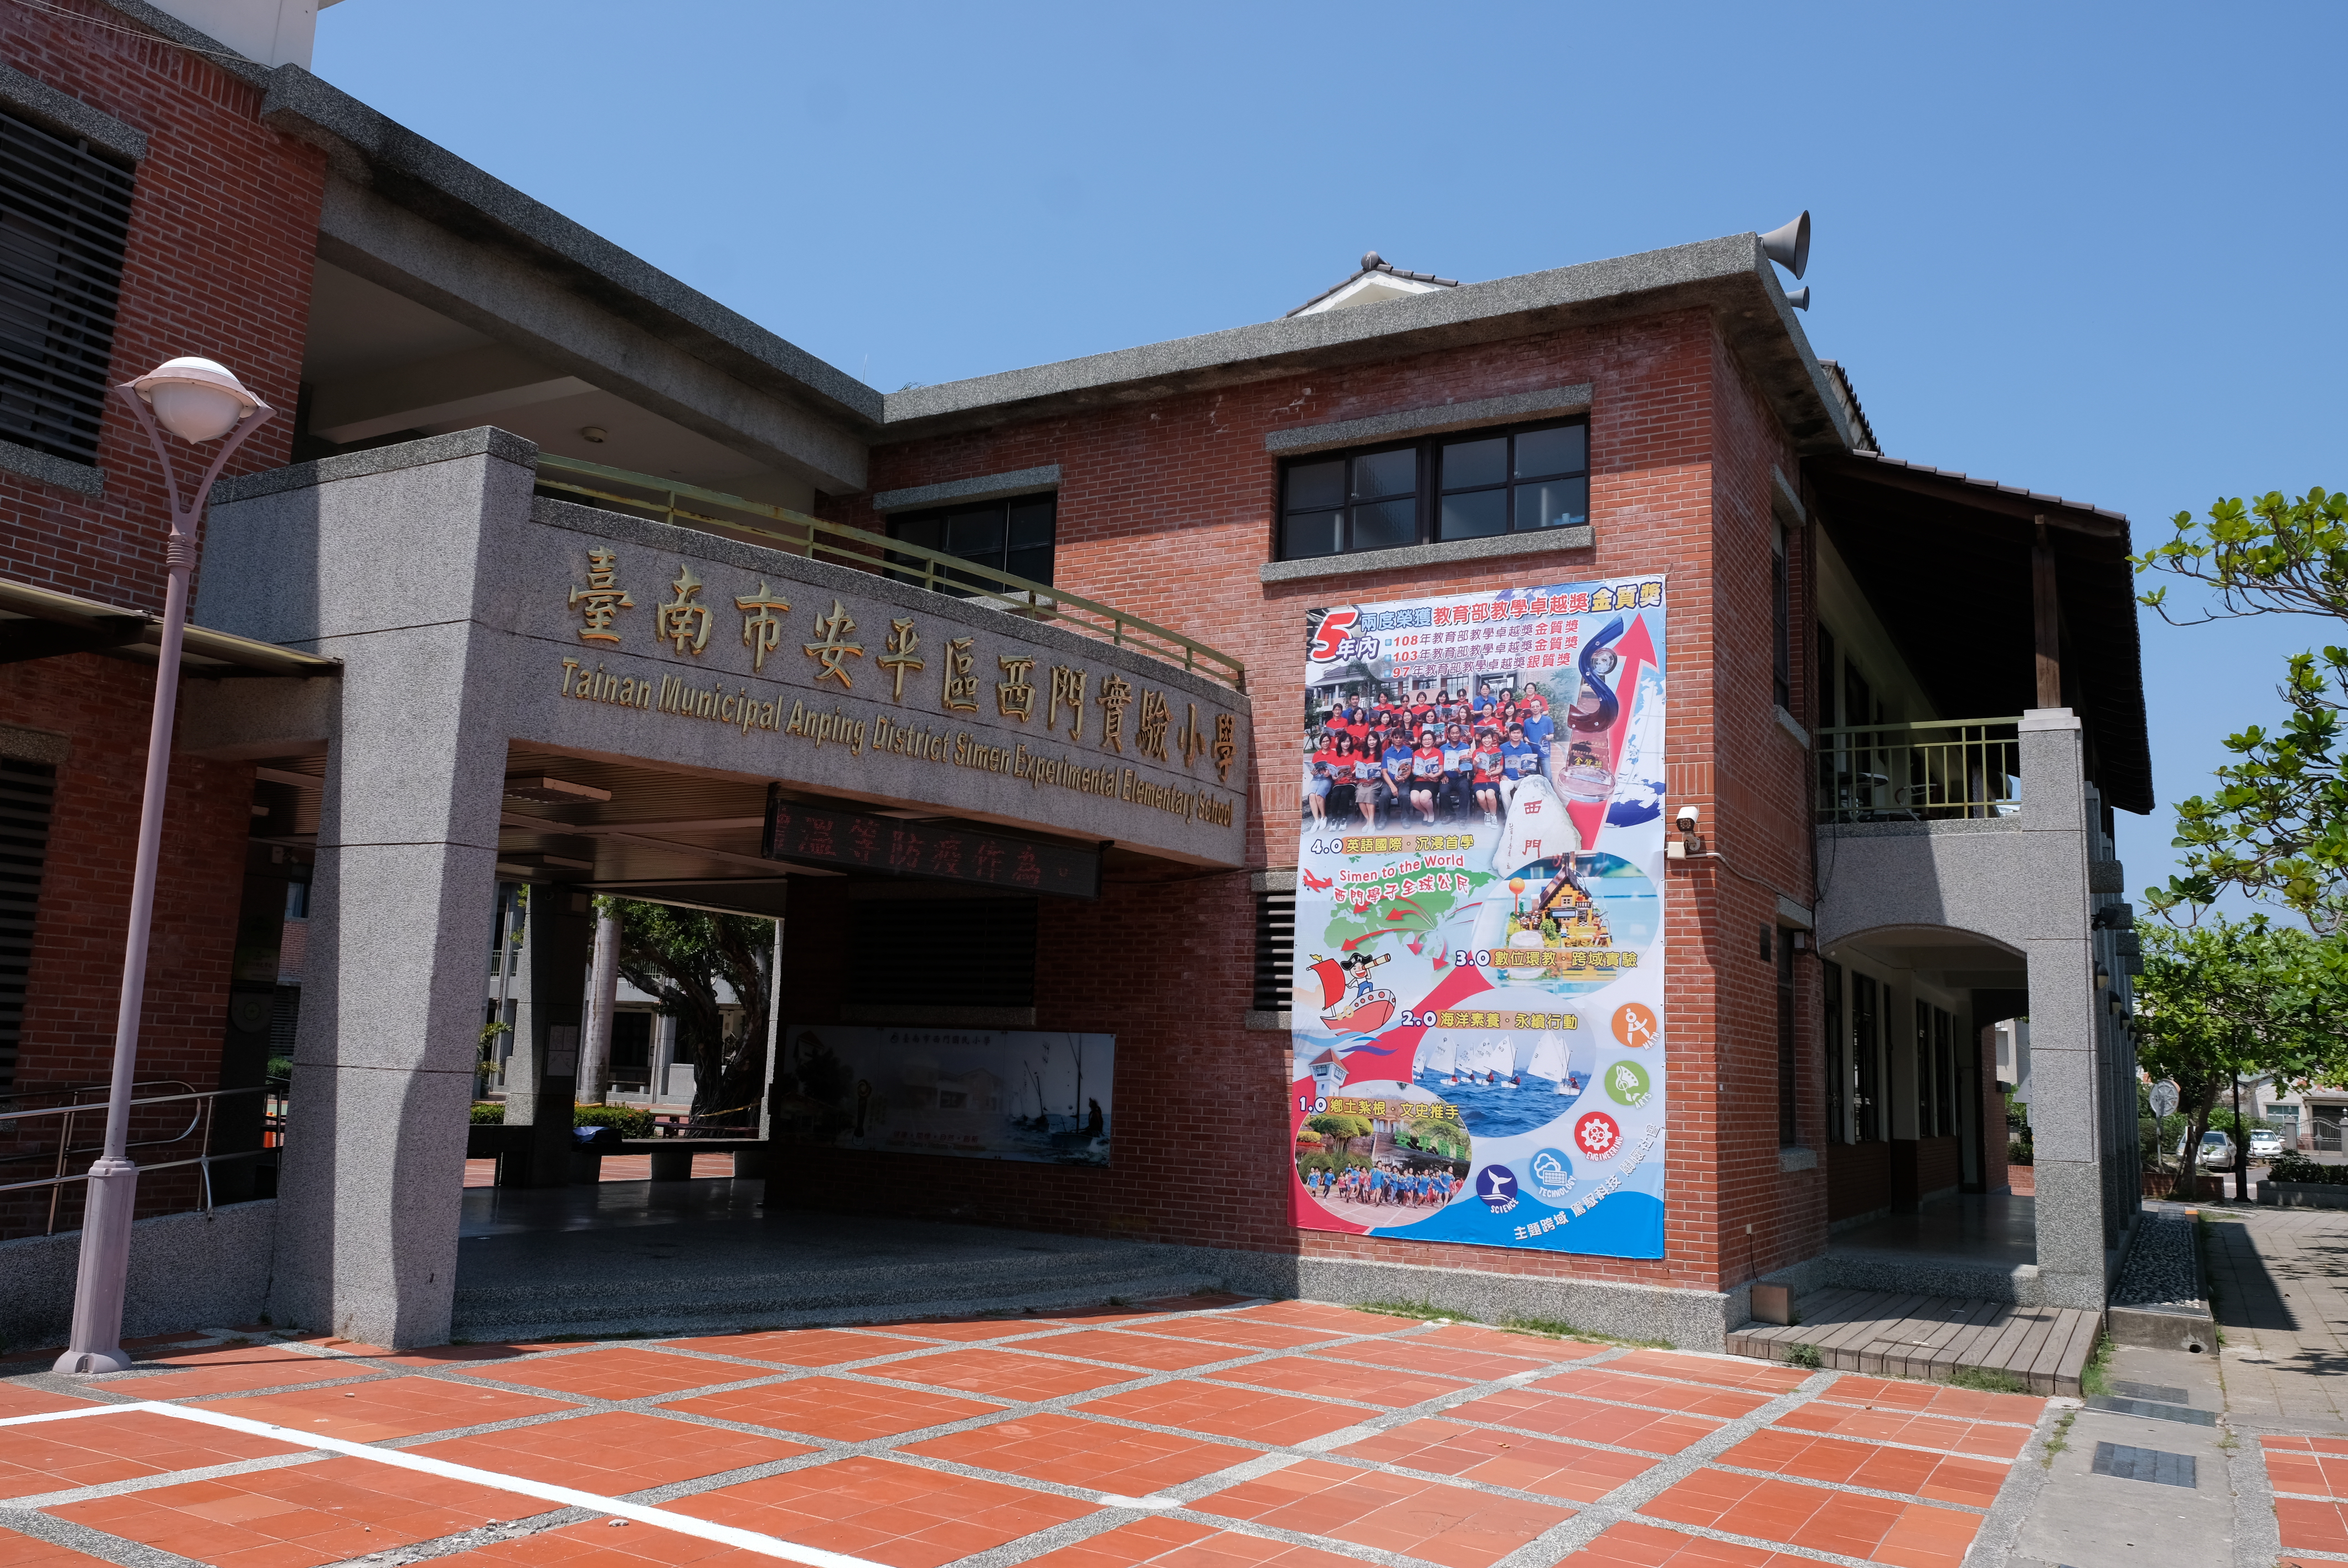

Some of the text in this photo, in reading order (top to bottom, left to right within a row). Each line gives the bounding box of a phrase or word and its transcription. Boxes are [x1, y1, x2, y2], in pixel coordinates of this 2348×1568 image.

[568, 545, 1237, 782] 臺南市安平區西門實驗小學
[562, 656, 1234, 827] Tainan Municipal Anping District Simen Experimental Elementary School
[1311, 838, 1343, 854] 4.0
[1339, 854, 1464, 882] Simen to the World
[1333, 875, 1469, 905] 西門學子全球公民
[1455, 950, 1491, 967] 3.0
[1402, 1010, 1437, 1028] 2.0
[1642, 1031, 1660, 1051] MATH
[1299, 1096, 1327, 1113] 1.0
[1635, 1092, 1652, 1110] ARTS
[1585, 1135, 1624, 1162] ENGINEERING
[1538, 1175, 1577, 1198] TECHNOLOGY
[1490, 1197, 1519, 1214] SCIENCE
[1514, 1211, 1569, 1241] 主題跨域
